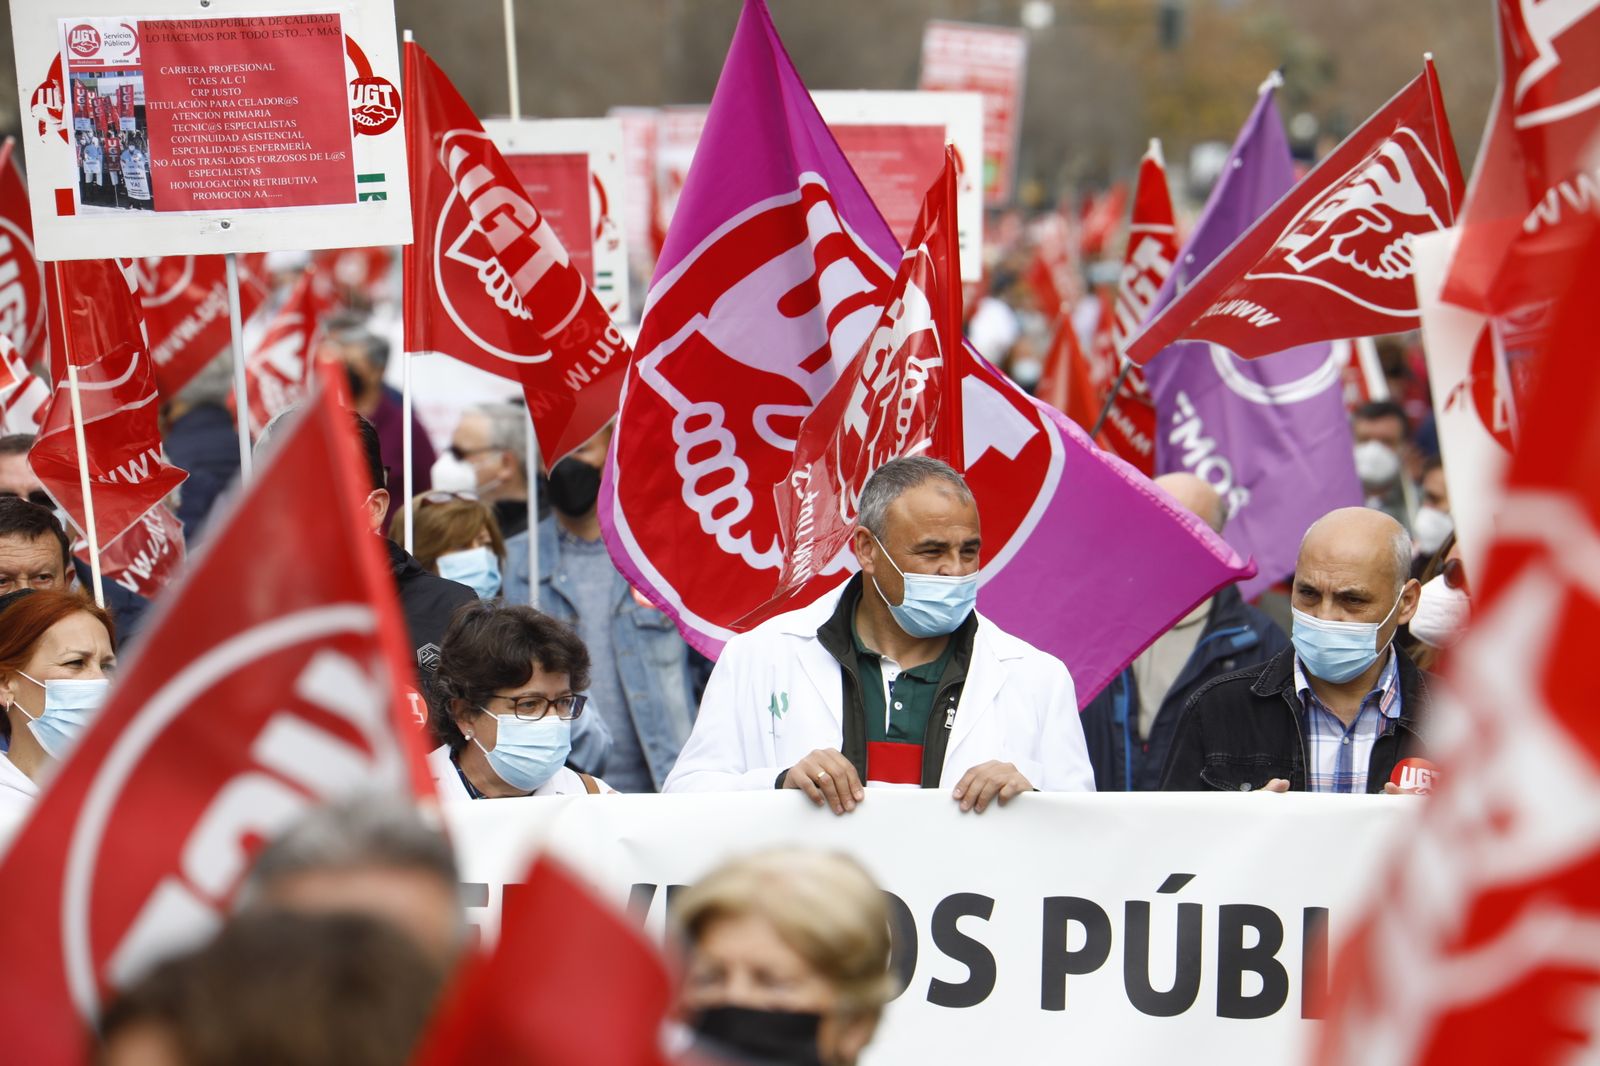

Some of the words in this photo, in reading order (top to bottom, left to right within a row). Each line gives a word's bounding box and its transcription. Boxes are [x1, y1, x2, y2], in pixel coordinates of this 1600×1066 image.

[144, 20, 168, 31] UNA
[168, 18, 218, 30] SANIDAD
[268, 16, 283, 26] DE
[285, 14, 333, 26] CALIDAD
[72, 30, 97, 42] UGT
[146, 34, 160, 44] LO
[162, 31, 214, 43] HACEMOS
[216, 31, 238, 41] POR
[240, 29, 270, 41] TODO
[160, 65, 206, 75] CARRERA
[208, 63, 276, 74] PROFESIONAL
[186, 76, 217, 86] TCAES
[220, 75, 233, 85] AL
[191, 88, 210, 97] CRP
[211, 87, 242, 97] JUSTO
[350, 84, 393, 108] UGT
[210, 99, 235, 109] PARA
[237, 96, 299, 108] CELADOR@S
[223, 108, 272, 119] PRIMARIA
[172, 122, 222, 133] TECNIC@S
[224, 119, 297, 131] ESPECIALISTAS
[171, 133, 240, 144] CONTINUIDAD
[241, 130, 304, 142] ASISTENCIAL
[172, 144, 248, 156] ESPCIALIDADES
[153, 158, 169, 168] NO
[170, 157, 196, 167] ALOS
[197, 155, 256, 166] TRASLADOS
[257, 153, 307, 164] FORZOSOS
[309, 152, 323, 162] DE
[325, 151, 346, 161] L@S
[188, 166, 262, 178] ESPECIALISTAS
[252, 175, 318, 187] RETRIBUTIVA
[449, 145, 570, 298] UGT
